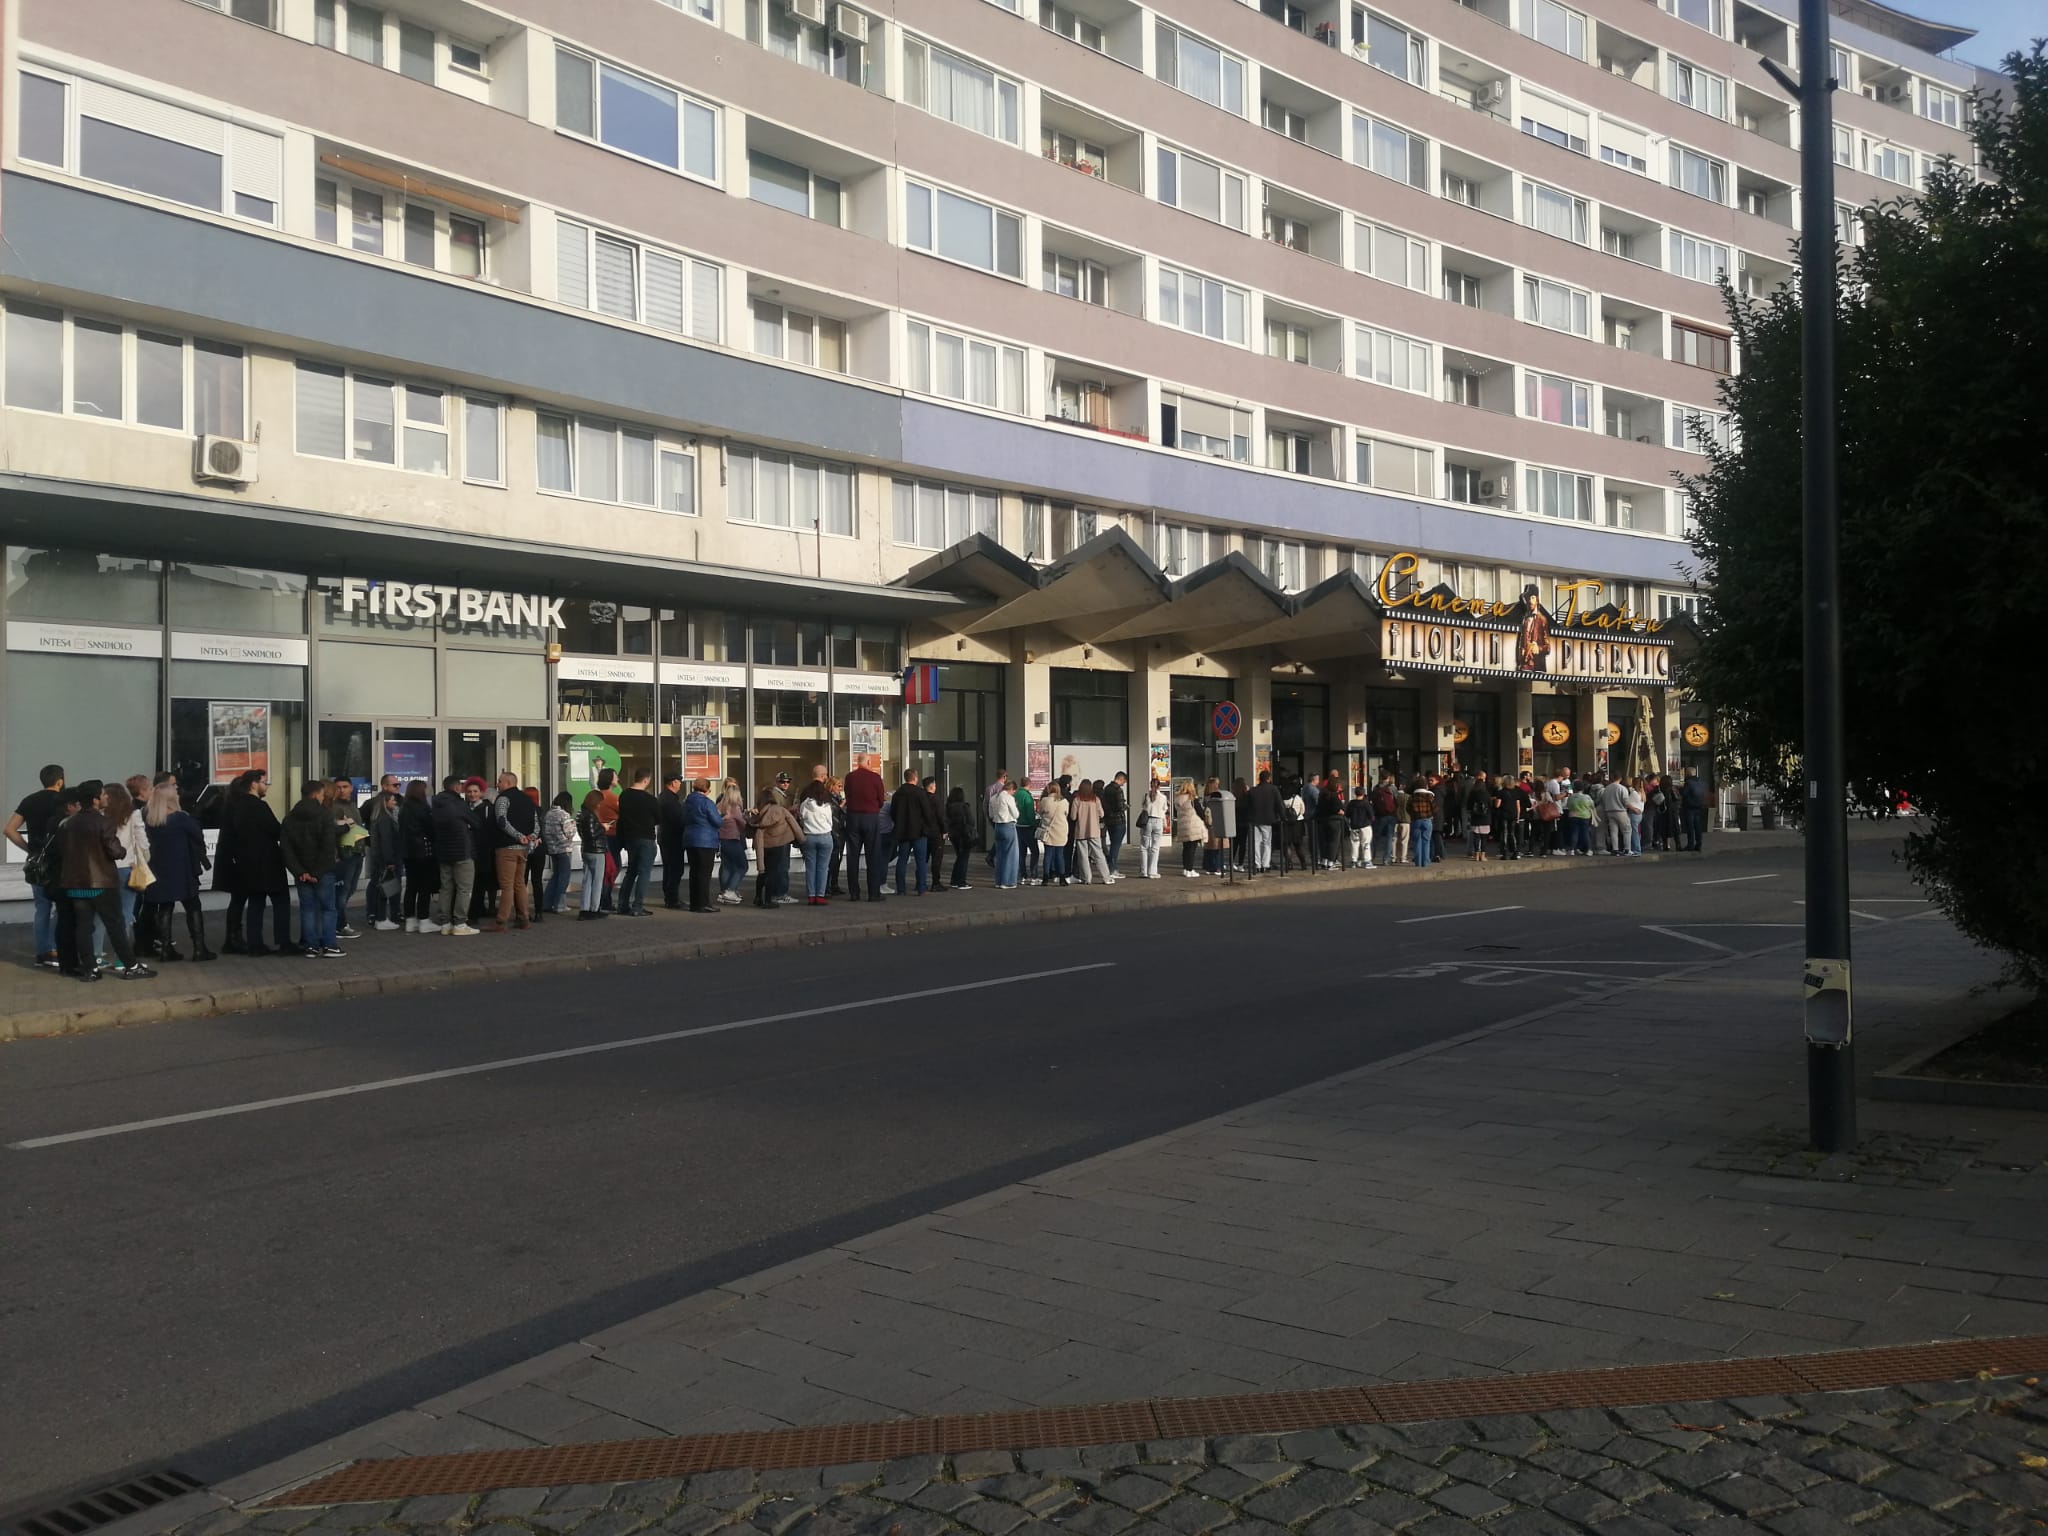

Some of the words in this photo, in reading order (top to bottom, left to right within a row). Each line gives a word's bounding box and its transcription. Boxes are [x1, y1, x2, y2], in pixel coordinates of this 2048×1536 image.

[1378, 552, 1521, 617] Cinema
[1556, 580, 1665, 633] Teatru
[39, 638, 71, 648] INTESA
[200, 647, 228, 656] INTESA
[1389, 622, 1501, 665] FLORIN
[1561, 639, 1668, 677] PIERSIC
[578, 669, 598, 677] INTESA
